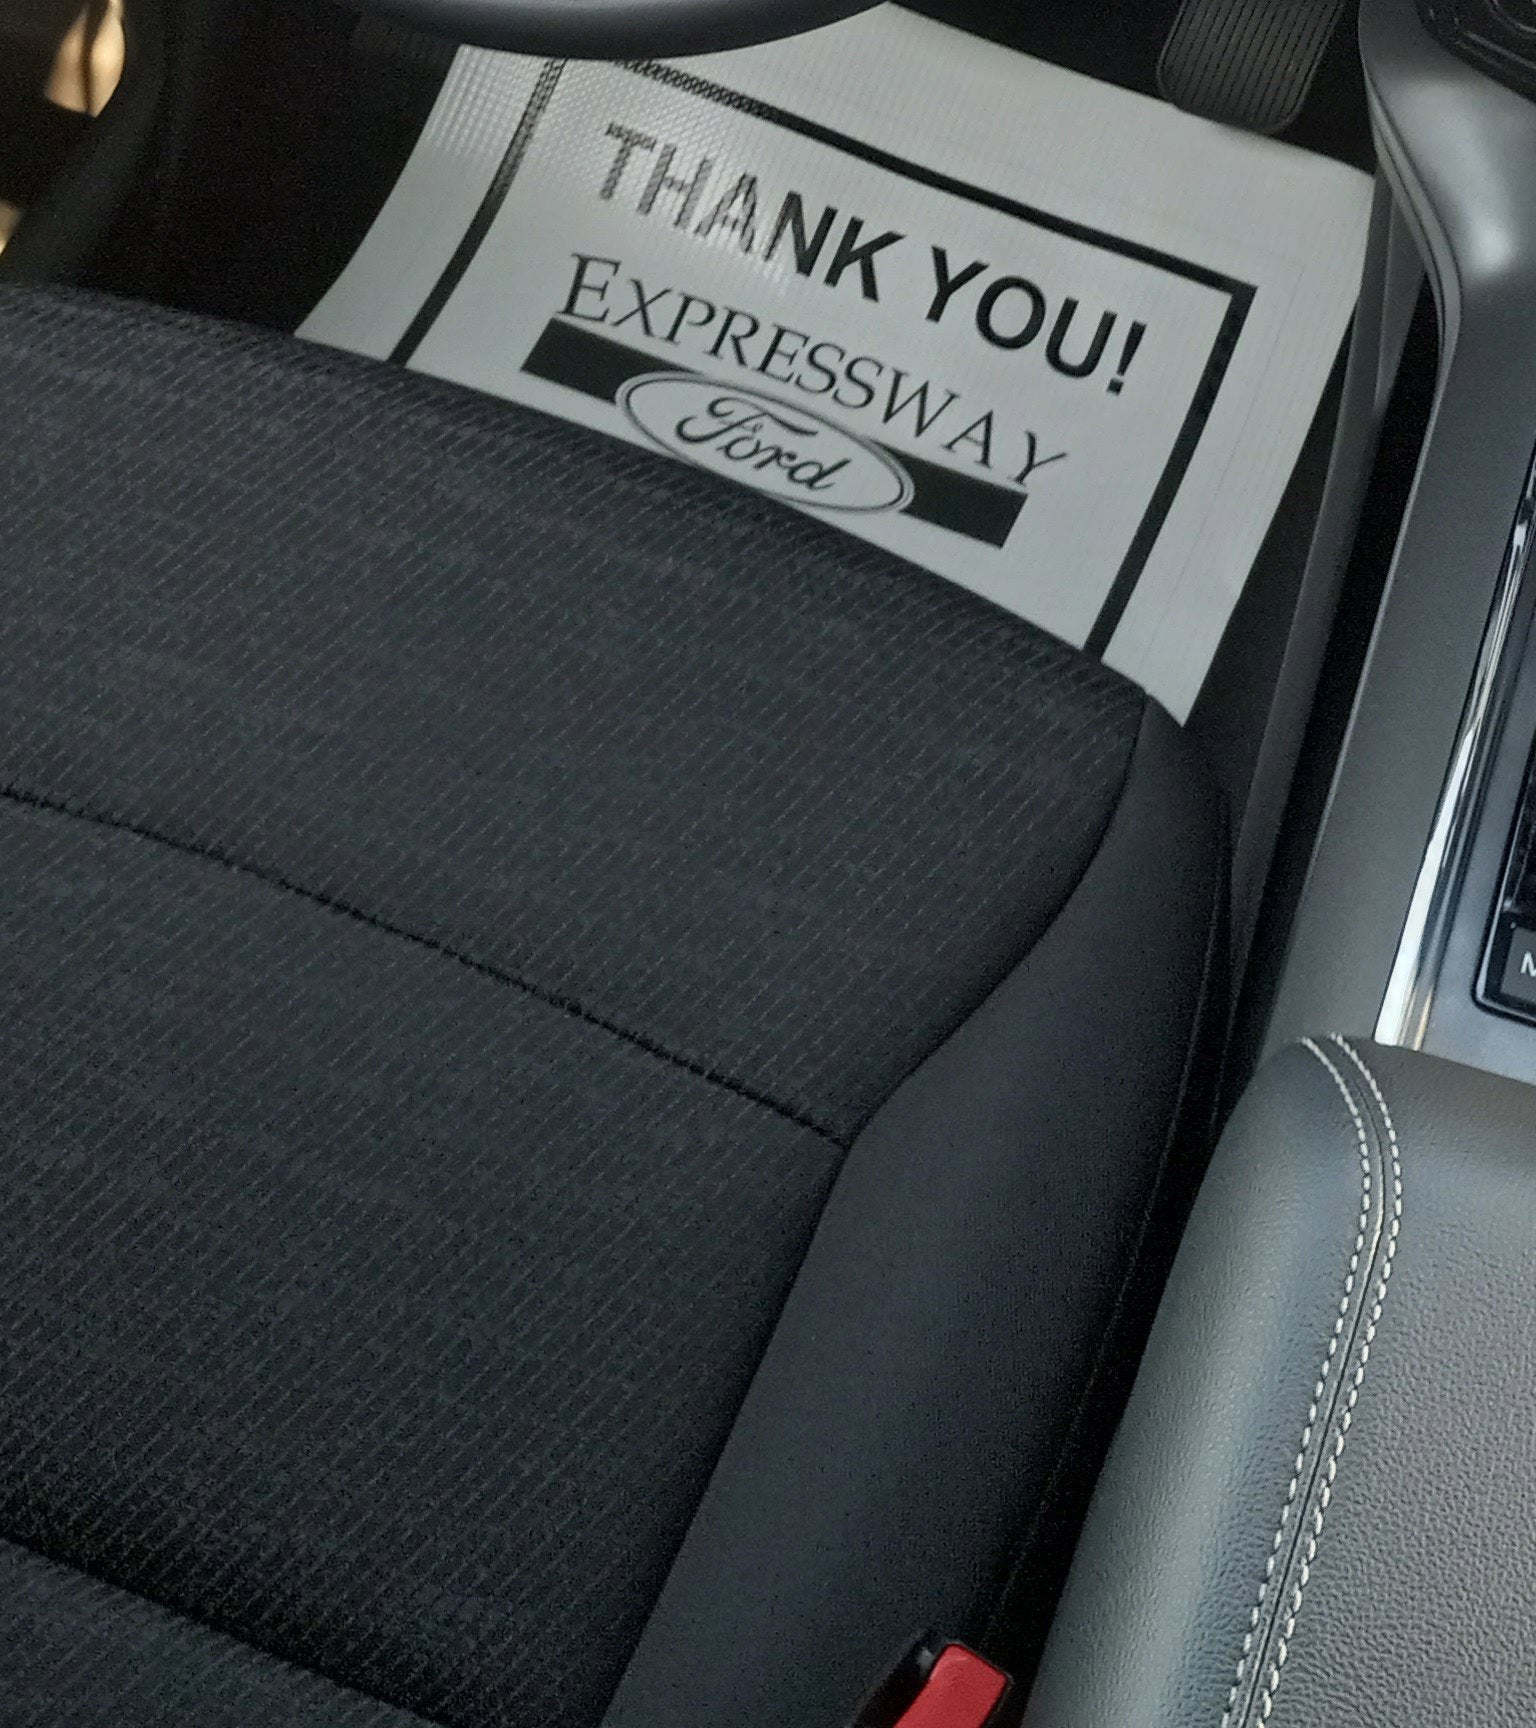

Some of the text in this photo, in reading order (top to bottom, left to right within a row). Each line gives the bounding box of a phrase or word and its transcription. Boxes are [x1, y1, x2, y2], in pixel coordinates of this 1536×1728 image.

[553, 252, 1069, 487] EXPRESSWAY
[595, 119, 1147, 394] THANK YOU!
[675, 395, 853, 493] Ford
